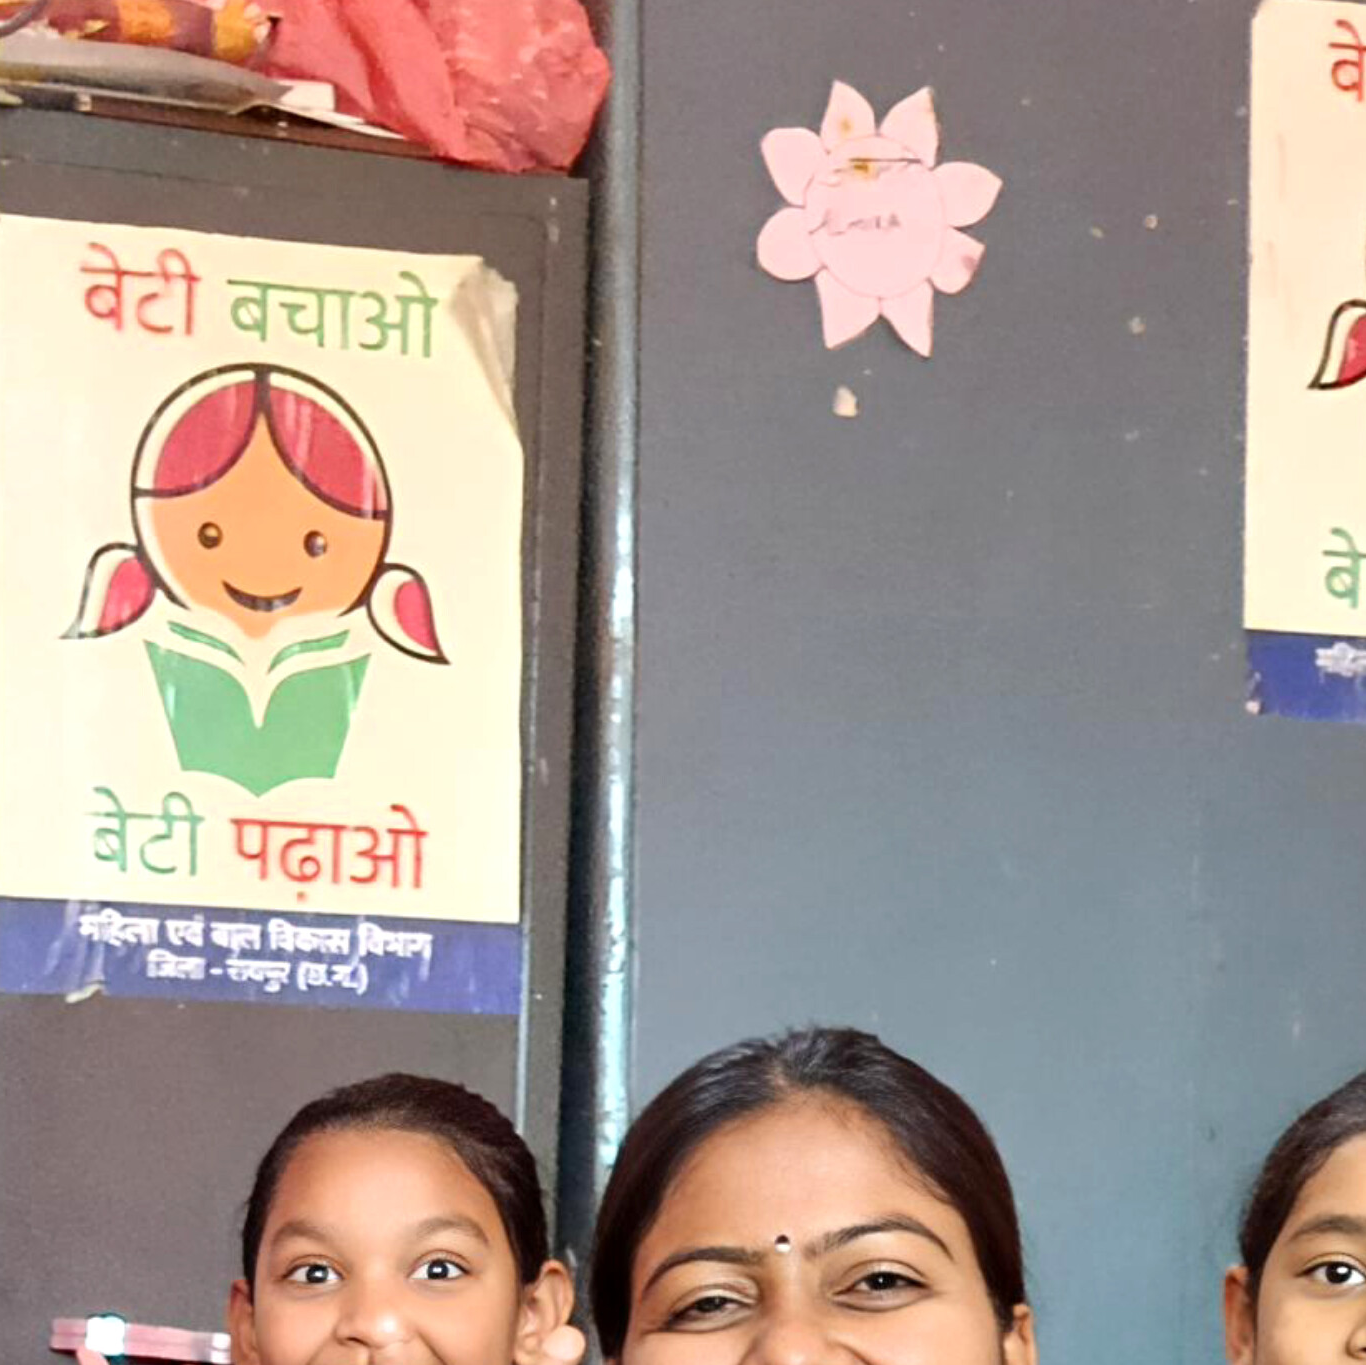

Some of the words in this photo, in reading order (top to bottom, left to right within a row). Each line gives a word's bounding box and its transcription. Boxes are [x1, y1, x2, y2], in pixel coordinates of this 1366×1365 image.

[226, 270, 439, 359] बचाओ
[84, 787, 205, 877] बेटी
[230, 803, 430, 904] पढ़ाओ
